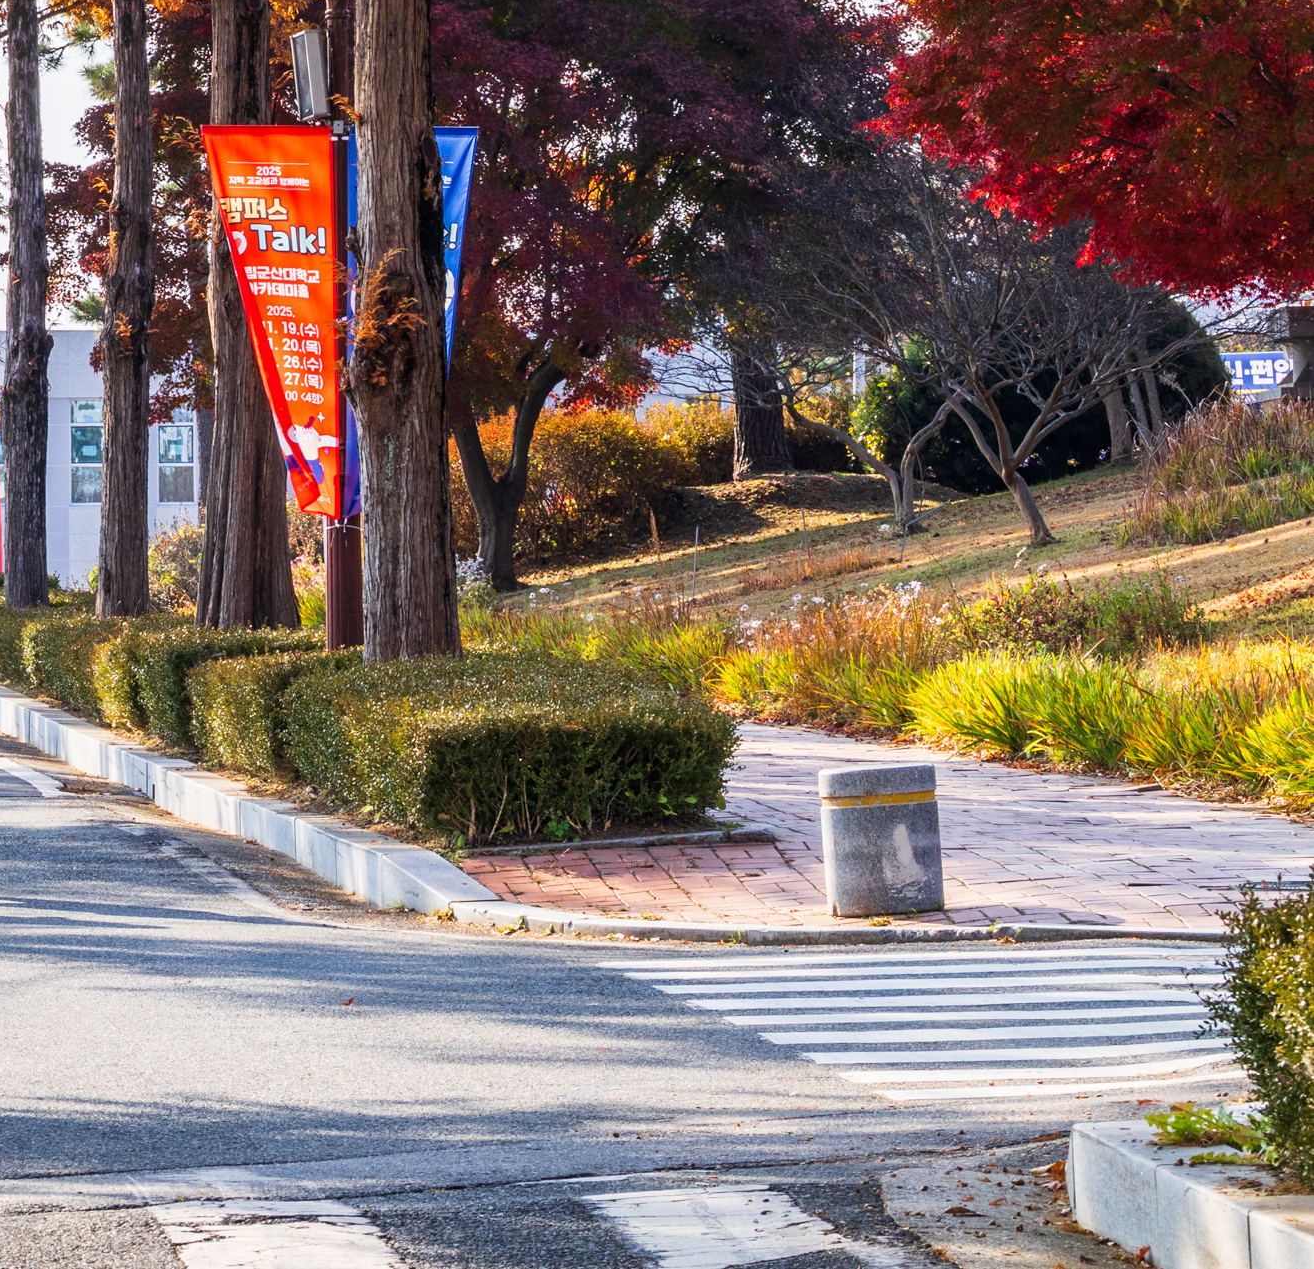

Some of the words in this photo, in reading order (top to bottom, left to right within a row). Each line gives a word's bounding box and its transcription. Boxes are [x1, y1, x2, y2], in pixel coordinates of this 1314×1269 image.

[256, 166, 281, 176] 2025
[228, 176, 244, 184] 지역
[219, 197, 288, 224] 캠퍼스
[249, 223, 326, 255] Talk!
[266, 305, 295, 318] 2025.
[282, 321, 319, 338] 19.(수)
[282, 338, 321, 355] 20.(목)
[283, 355, 323, 372] 26.(수)
[284, 372, 324, 389] 27.(목)
